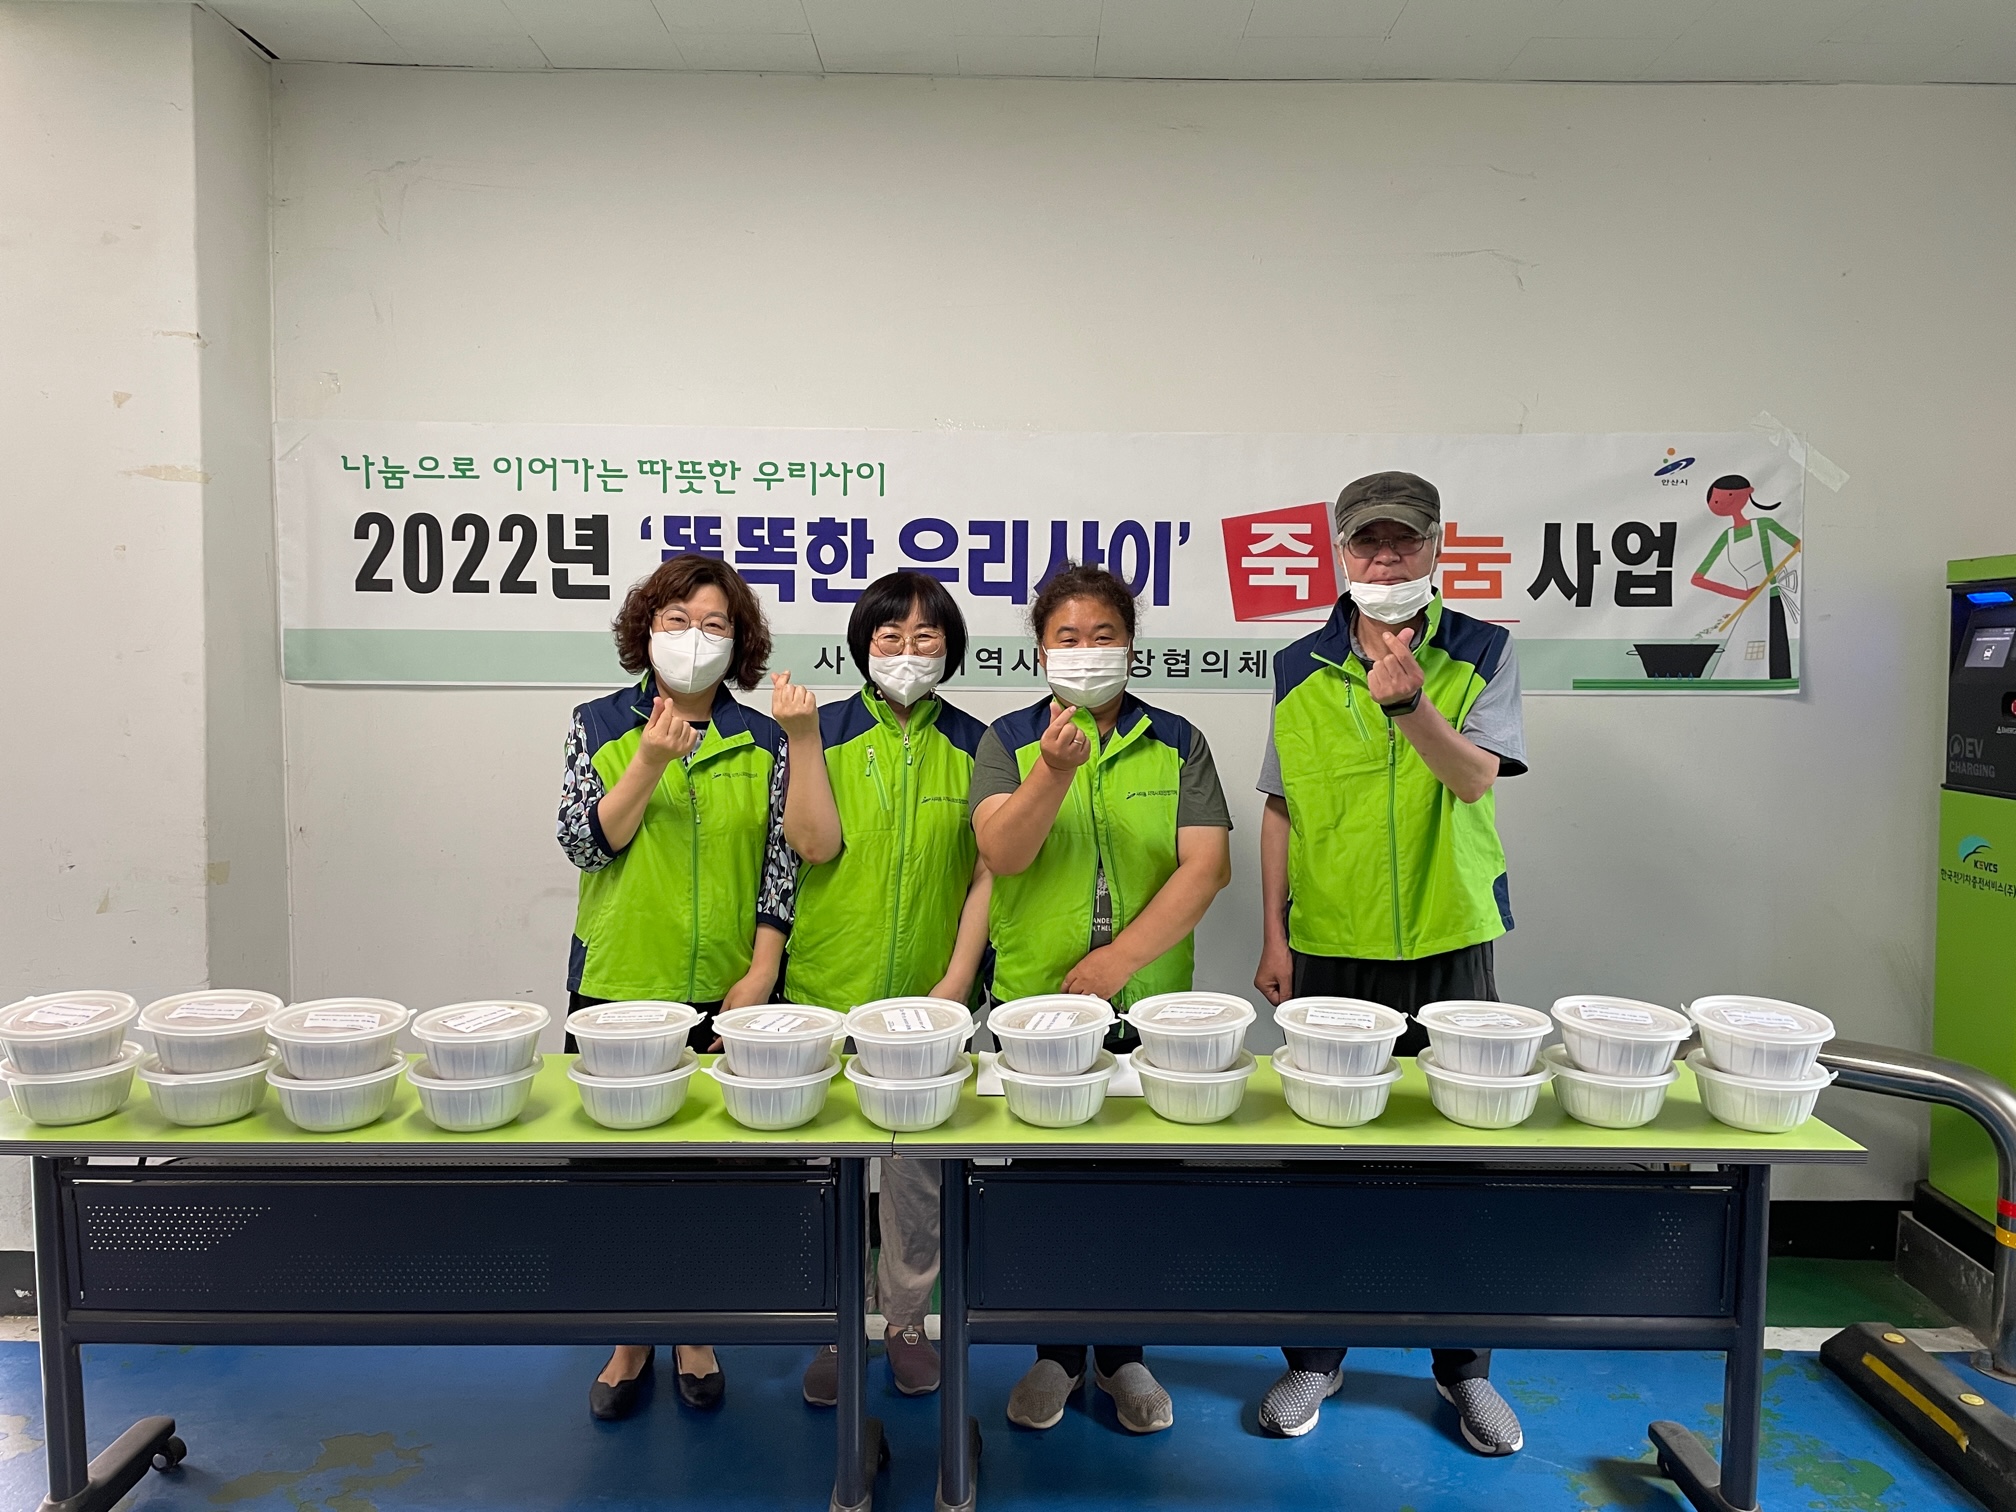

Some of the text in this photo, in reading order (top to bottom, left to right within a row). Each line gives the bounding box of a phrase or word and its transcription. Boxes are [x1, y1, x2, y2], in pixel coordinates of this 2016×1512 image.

[341, 454, 885, 497] 나눔으로 이어가는 따뜻한 우리사이
[354, 511, 611, 600] 2022년
[1241, 522, 1320, 600] 죽
[1526, 521, 1677, 607] 사업
[1965, 737, 1984, 758] EV
[1949, 761, 1995, 778] CHARGING
[1974, 860, 1998, 873] KEVCS
